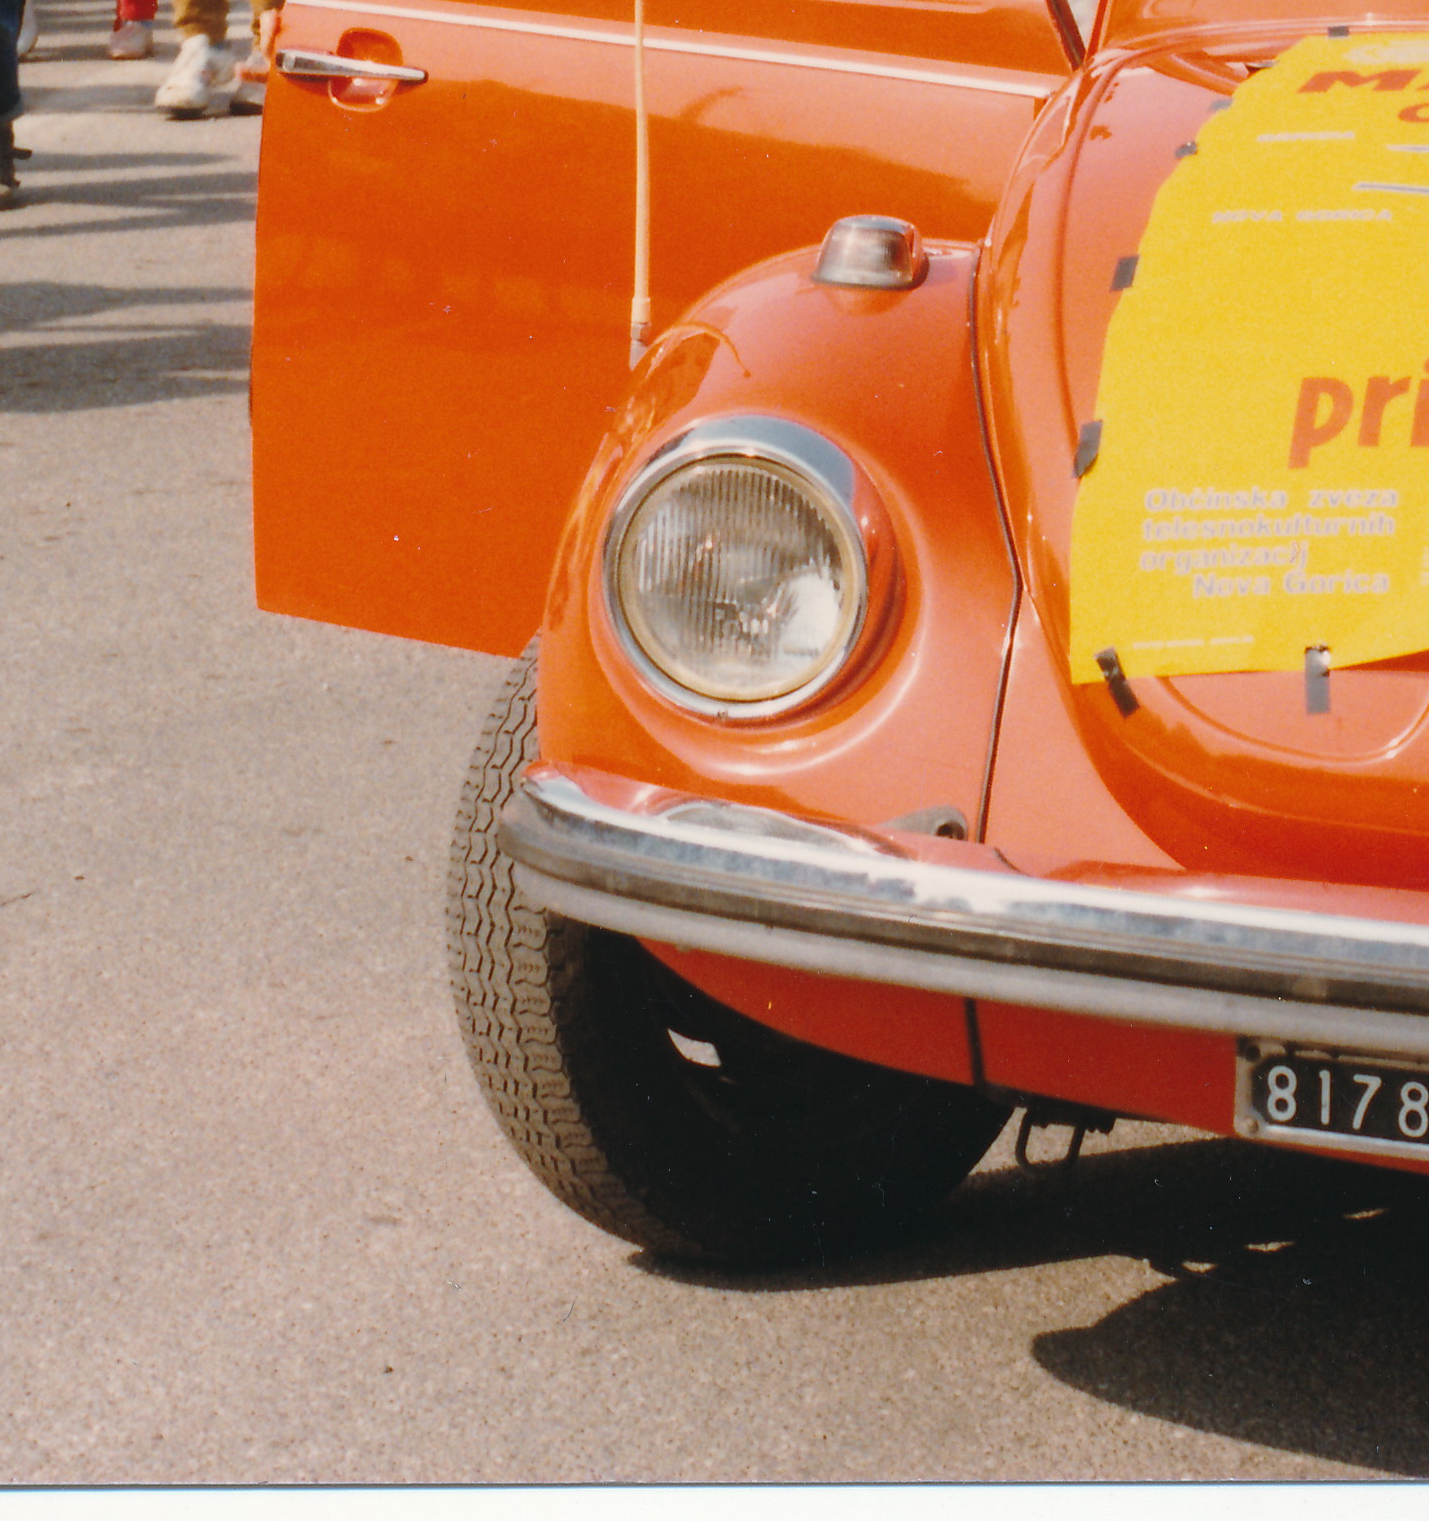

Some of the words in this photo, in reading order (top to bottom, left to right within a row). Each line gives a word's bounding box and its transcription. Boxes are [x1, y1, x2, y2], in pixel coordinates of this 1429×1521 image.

[1144, 485, 1288, 512] Občinska
[1308, 488, 1398, 508] zveza
[1142, 511, 1396, 542] telesnokulturnih
[1139, 540, 1309, 577] organizacij
[1192, 572, 1271, 598] Nova
[1283, 568, 1390, 595] Gorica
